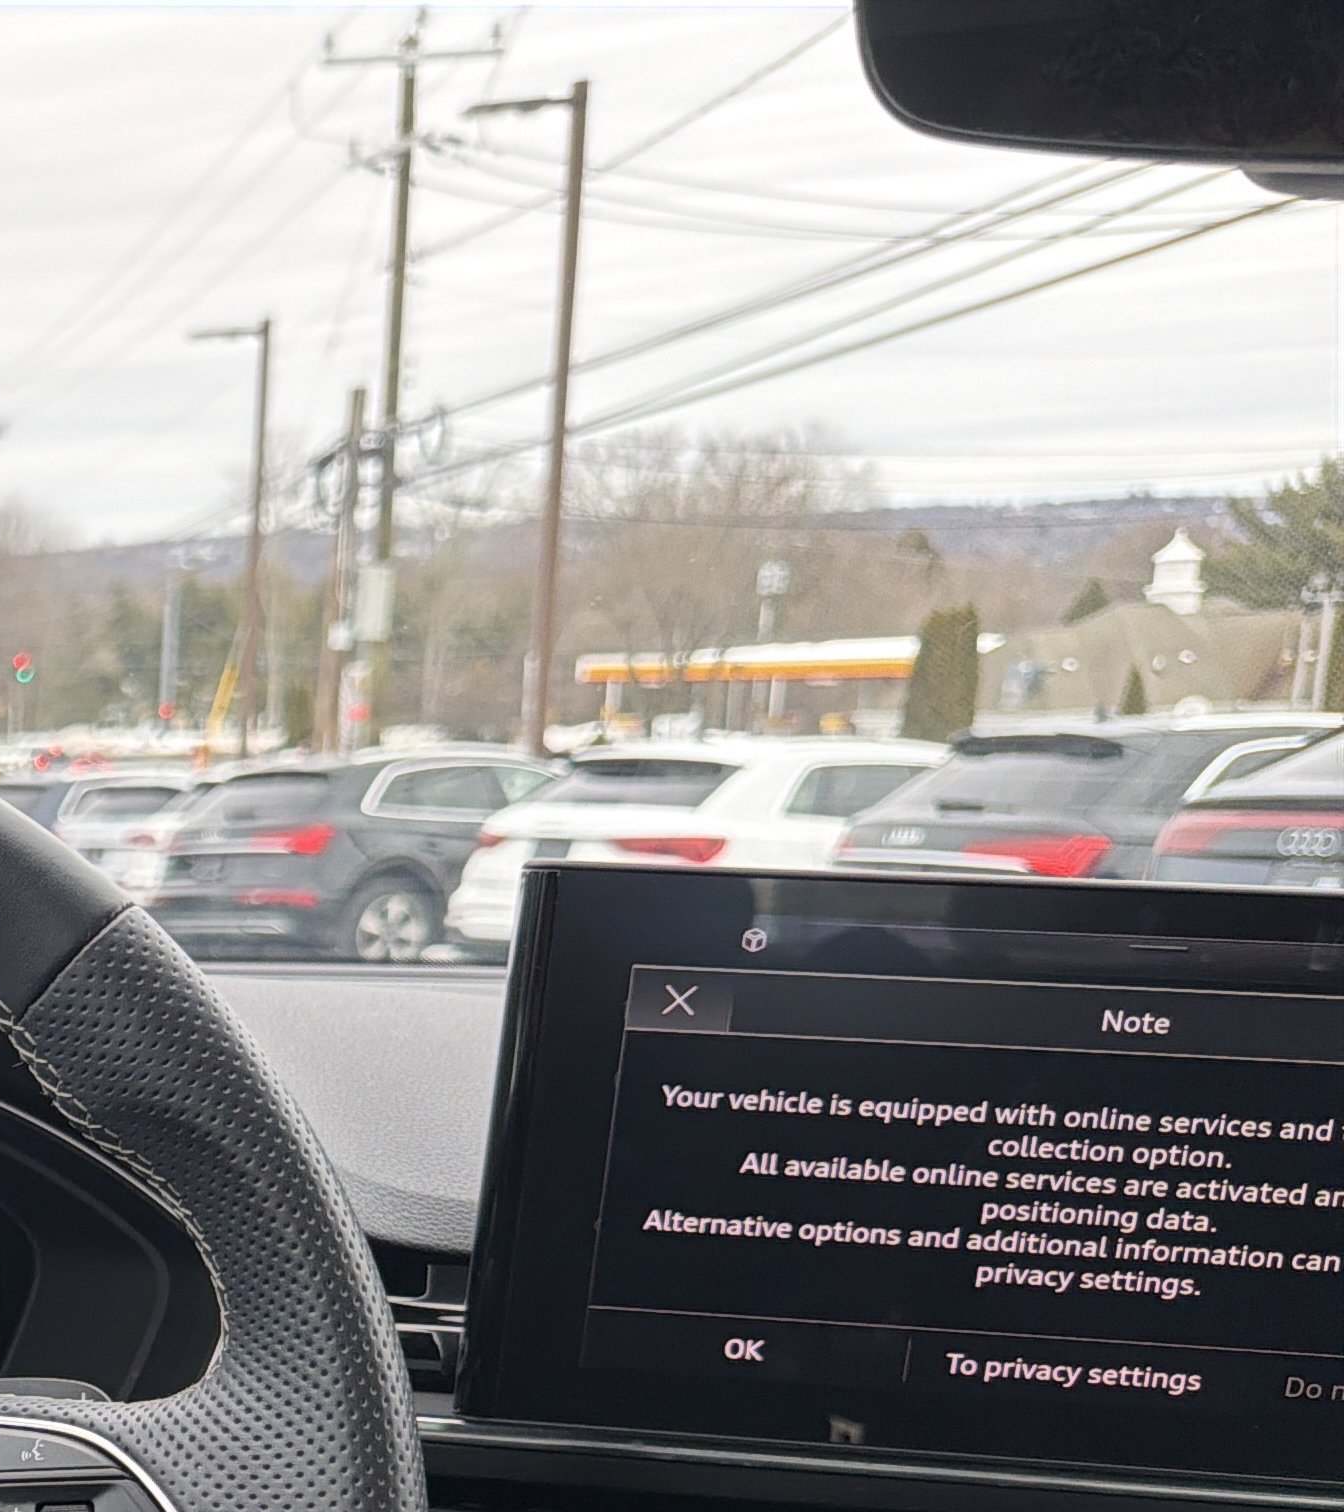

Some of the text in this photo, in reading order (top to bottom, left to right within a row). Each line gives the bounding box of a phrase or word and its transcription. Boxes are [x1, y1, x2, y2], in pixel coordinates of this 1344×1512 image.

[1102, 1009, 1171, 1035] Note
[662, 1084, 724, 1109] Your
[728, 1089, 824, 1114] vehicle
[829, 1094, 852, 1115] is
[858, 1098, 988, 1126] equipped
[994, 1103, 1056, 1128] with
[1063, 1107, 1151, 1132] online
[1157, 1113, 1272, 1138] services
[1279, 1118, 1334, 1141] and
[988, 1135, 1233, 1170] collection option.
[739, 1152, 779, 1176] All
[783, 1156, 906, 1183] available
[912, 1163, 999, 1188] online
[1005, 1170, 1117, 1196] services
[1123, 1179, 1168, 1198] are
[1175, 1179, 1308, 1206] activated
[980, 1202, 1217, 1234] positioning data.
[642, 1208, 1341, 1273] Alternative options and additional information can
[975, 1263, 1201, 1300] privacy settings.
[724, 1338, 765, 1361] OK
[946, 1352, 1202, 1396] To privacy settings
[1284, 1376, 1322, 1398] Do
